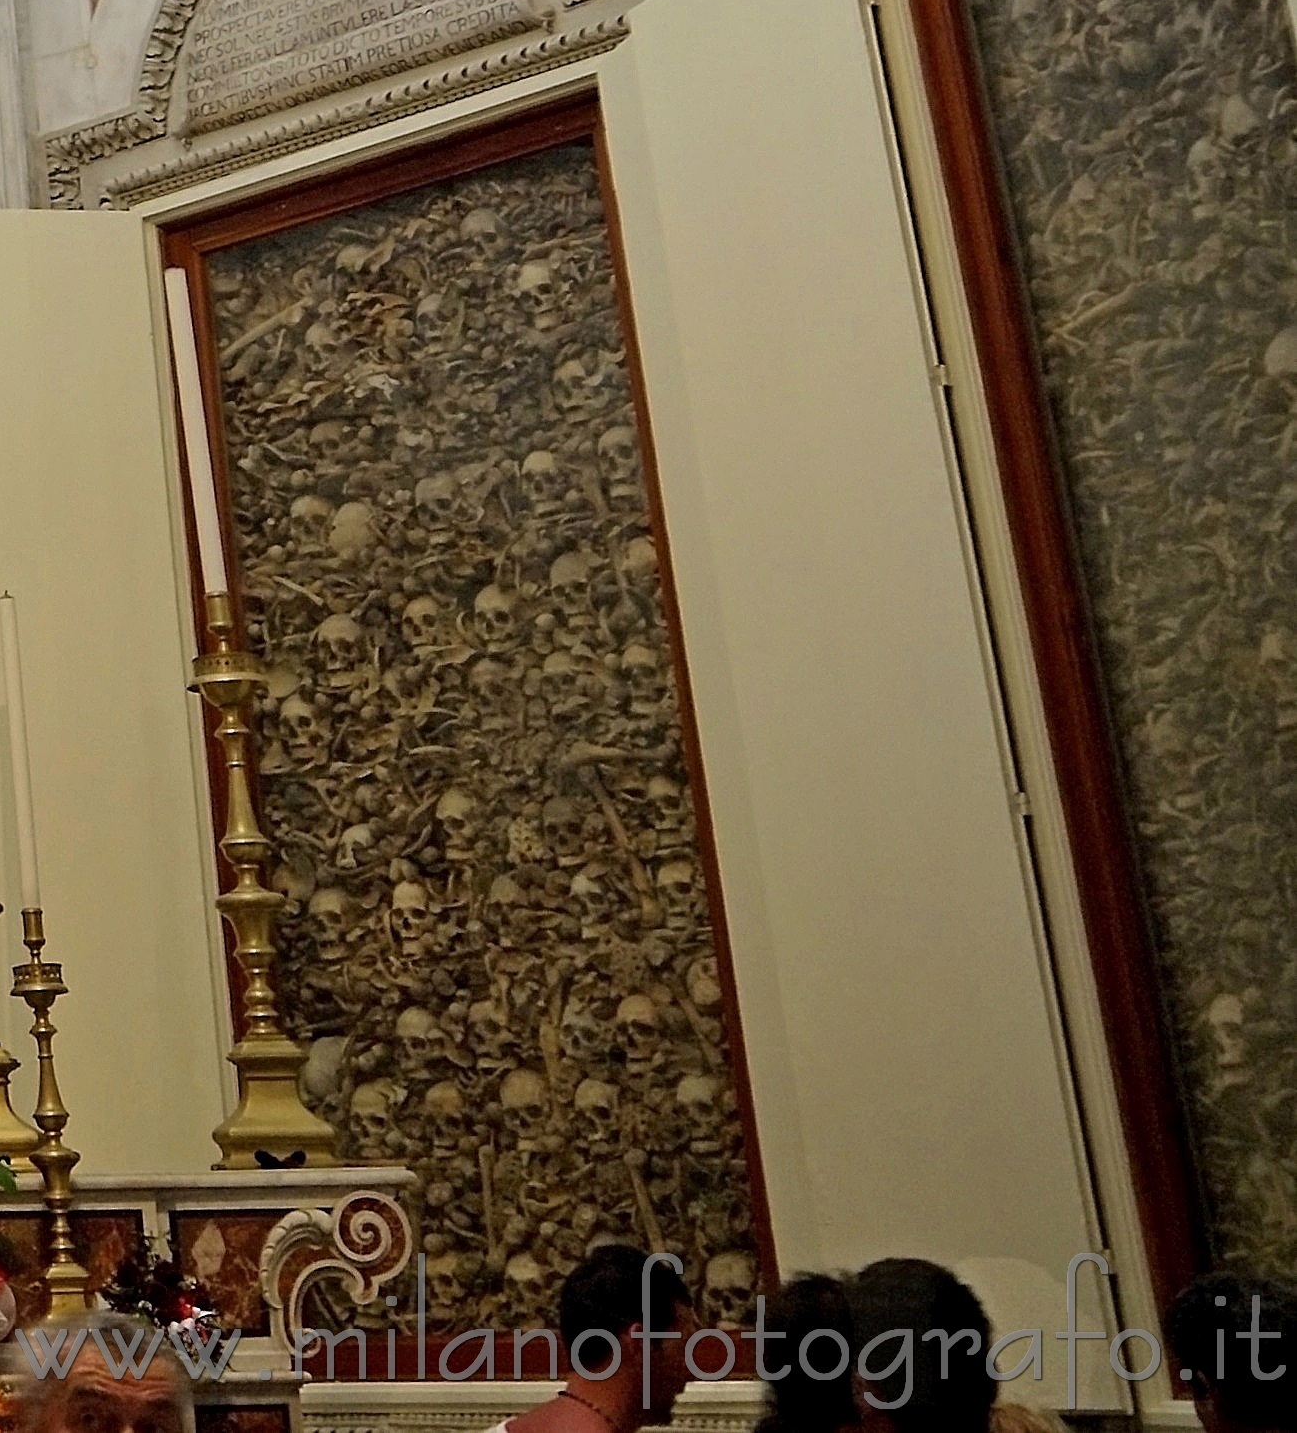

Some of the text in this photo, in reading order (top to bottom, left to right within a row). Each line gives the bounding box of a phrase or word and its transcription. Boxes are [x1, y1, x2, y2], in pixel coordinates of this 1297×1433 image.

[188, 45, 212, 67] NEC
[215, 35, 243, 57] SOL
[244, 25, 270, 48] NEC
[288, 44, 329, 71] TOTO
[333, 27, 379, 56] DICTO
[384, 0, 453, 38] TEMPORE
[308, 50, 361, 82] STATIM
[367, 24, 440, 64] PRETIOSA
